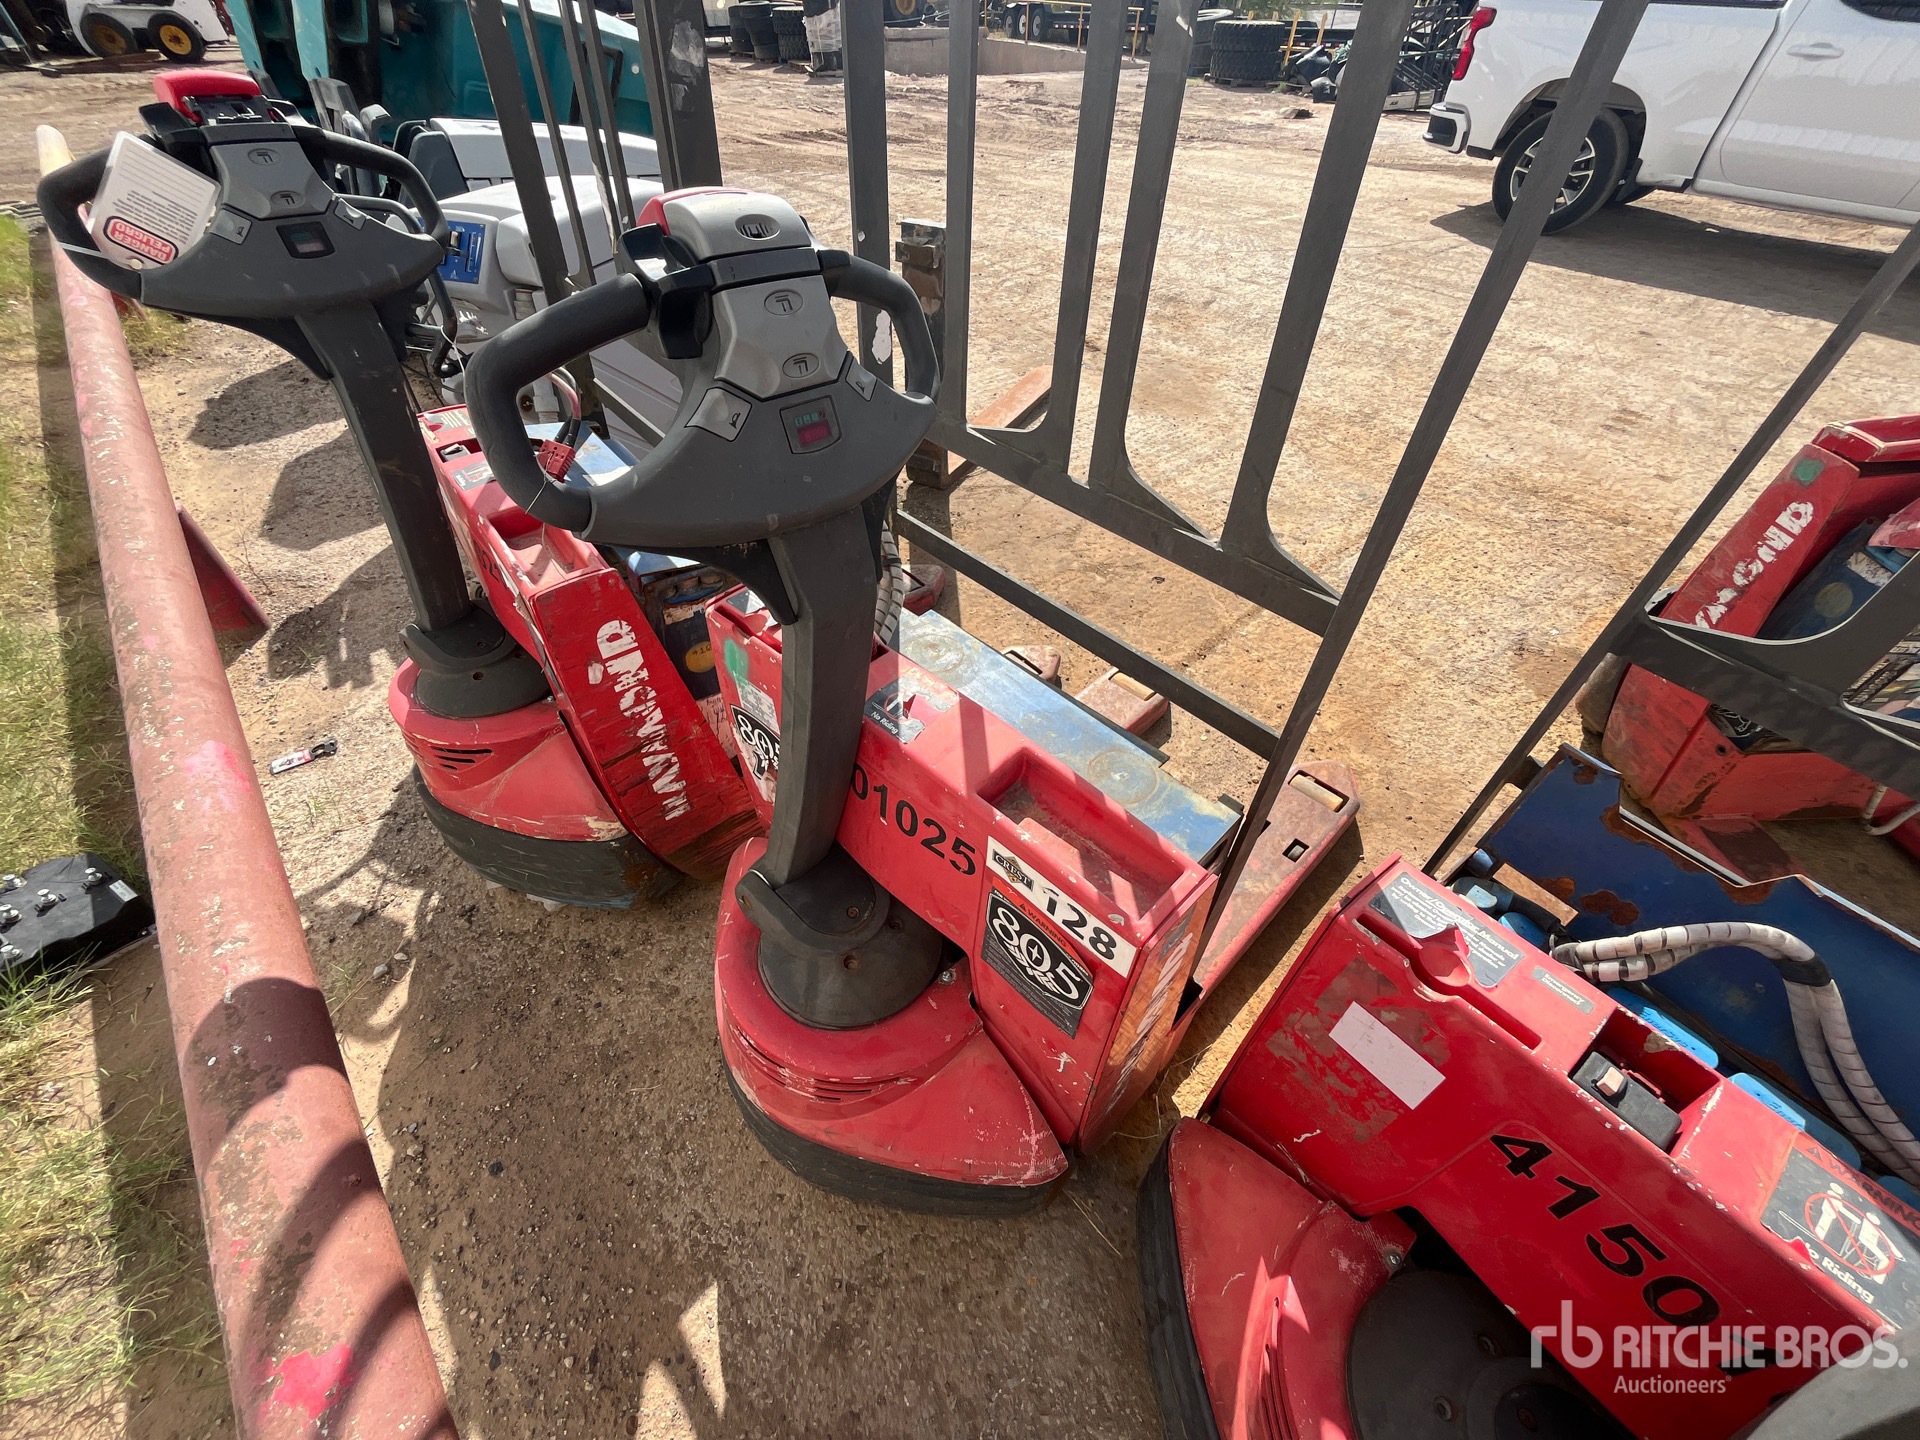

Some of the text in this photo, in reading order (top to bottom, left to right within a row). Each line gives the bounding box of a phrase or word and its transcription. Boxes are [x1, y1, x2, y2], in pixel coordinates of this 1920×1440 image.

[112, 230, 168, 261] DANGER
[115, 221, 174, 253] PELIGRO
[870, 710, 899, 735] No Riding
[993, 853, 1117, 960] CREST 128
[1027, 911, 1067, 948] WARNING
[1479, 930, 1518, 960] Manual
[992, 907, 1079, 1000] 805
[1821, 1256, 1875, 1305] Riding
